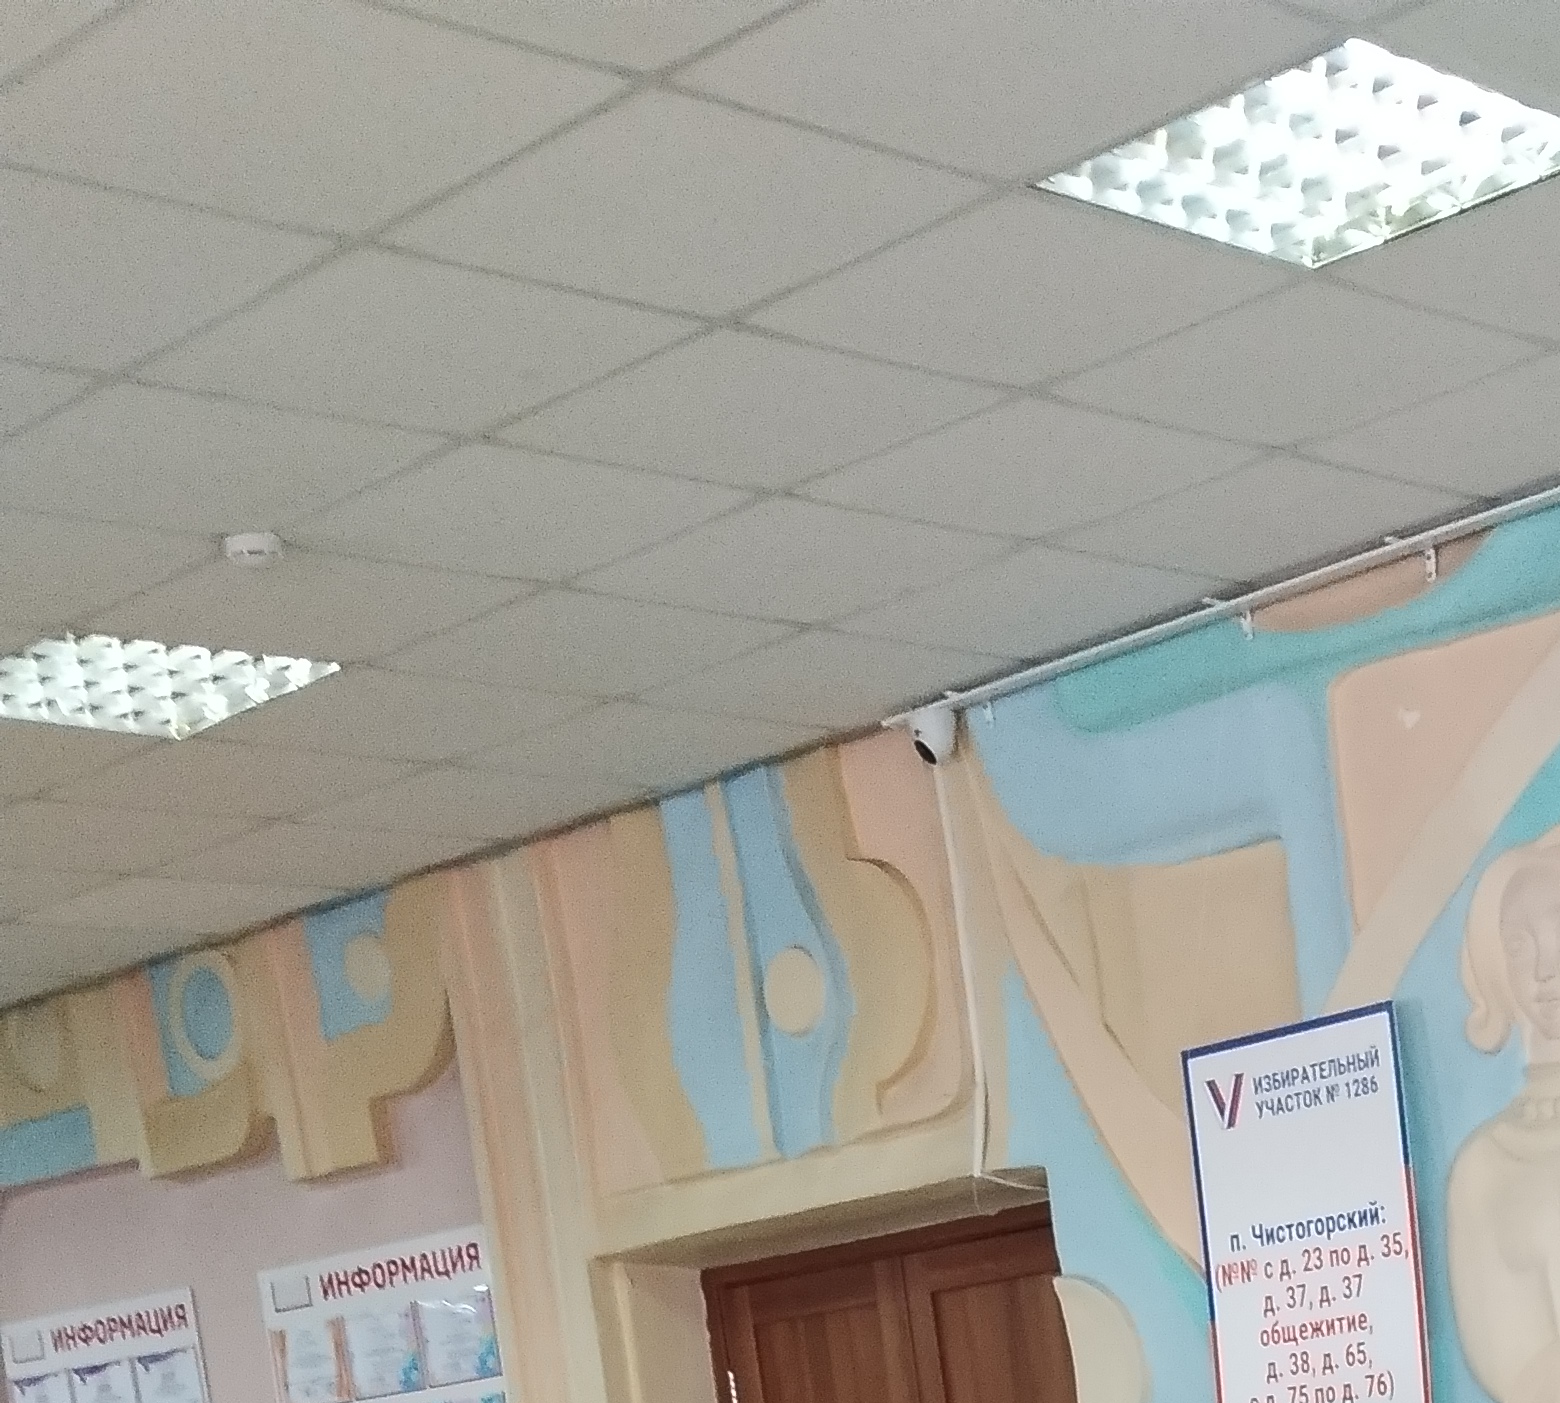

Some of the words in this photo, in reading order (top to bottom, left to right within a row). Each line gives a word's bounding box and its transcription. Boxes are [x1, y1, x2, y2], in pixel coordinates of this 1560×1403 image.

[1252, 1045, 1380, 1095] ИЗБИРАТЕЛЬНЫЙ
[1255, 1087, 1323, 1119] УЧАСТОК
[1345, 1075, 1379, 1100] 1286
[1229, 1233, 1247, 1252] п.
[1251, 1200, 1387, 1247] Чистогорский:
[319, 1242, 483, 1301] ИНФОРМАЦИЯ
[1263, 1261, 1274, 1279] с
[1279, 1258, 1297, 1281] д.
[1301, 1246, 1324, 1272] 23
[1329, 1247, 1351, 1267] по
[1356, 1244, 1375, 1268] д.
[1380, 1231, 1410, 1260] 35,
[1263, 1295, 1280, 1318] д.
[1285, 1283, 1313, 1310] 37,
[1319, 1285, 1337, 1308] д.
[1342, 1273, 1363, 1299] 37
[50, 1303, 189, 1352] ИНФОРМАЦИЯ
[1260, 1312, 1374, 1347] общежитие,
[1266, 1361, 1284, 1384] д.
[1289, 1350, 1316, 1378] 38,
[1321, 1352, 1340, 1376] д.
[1345, 1341, 1373, 1369] 65,
[1364, 1369, 1395, 1401] 76)
